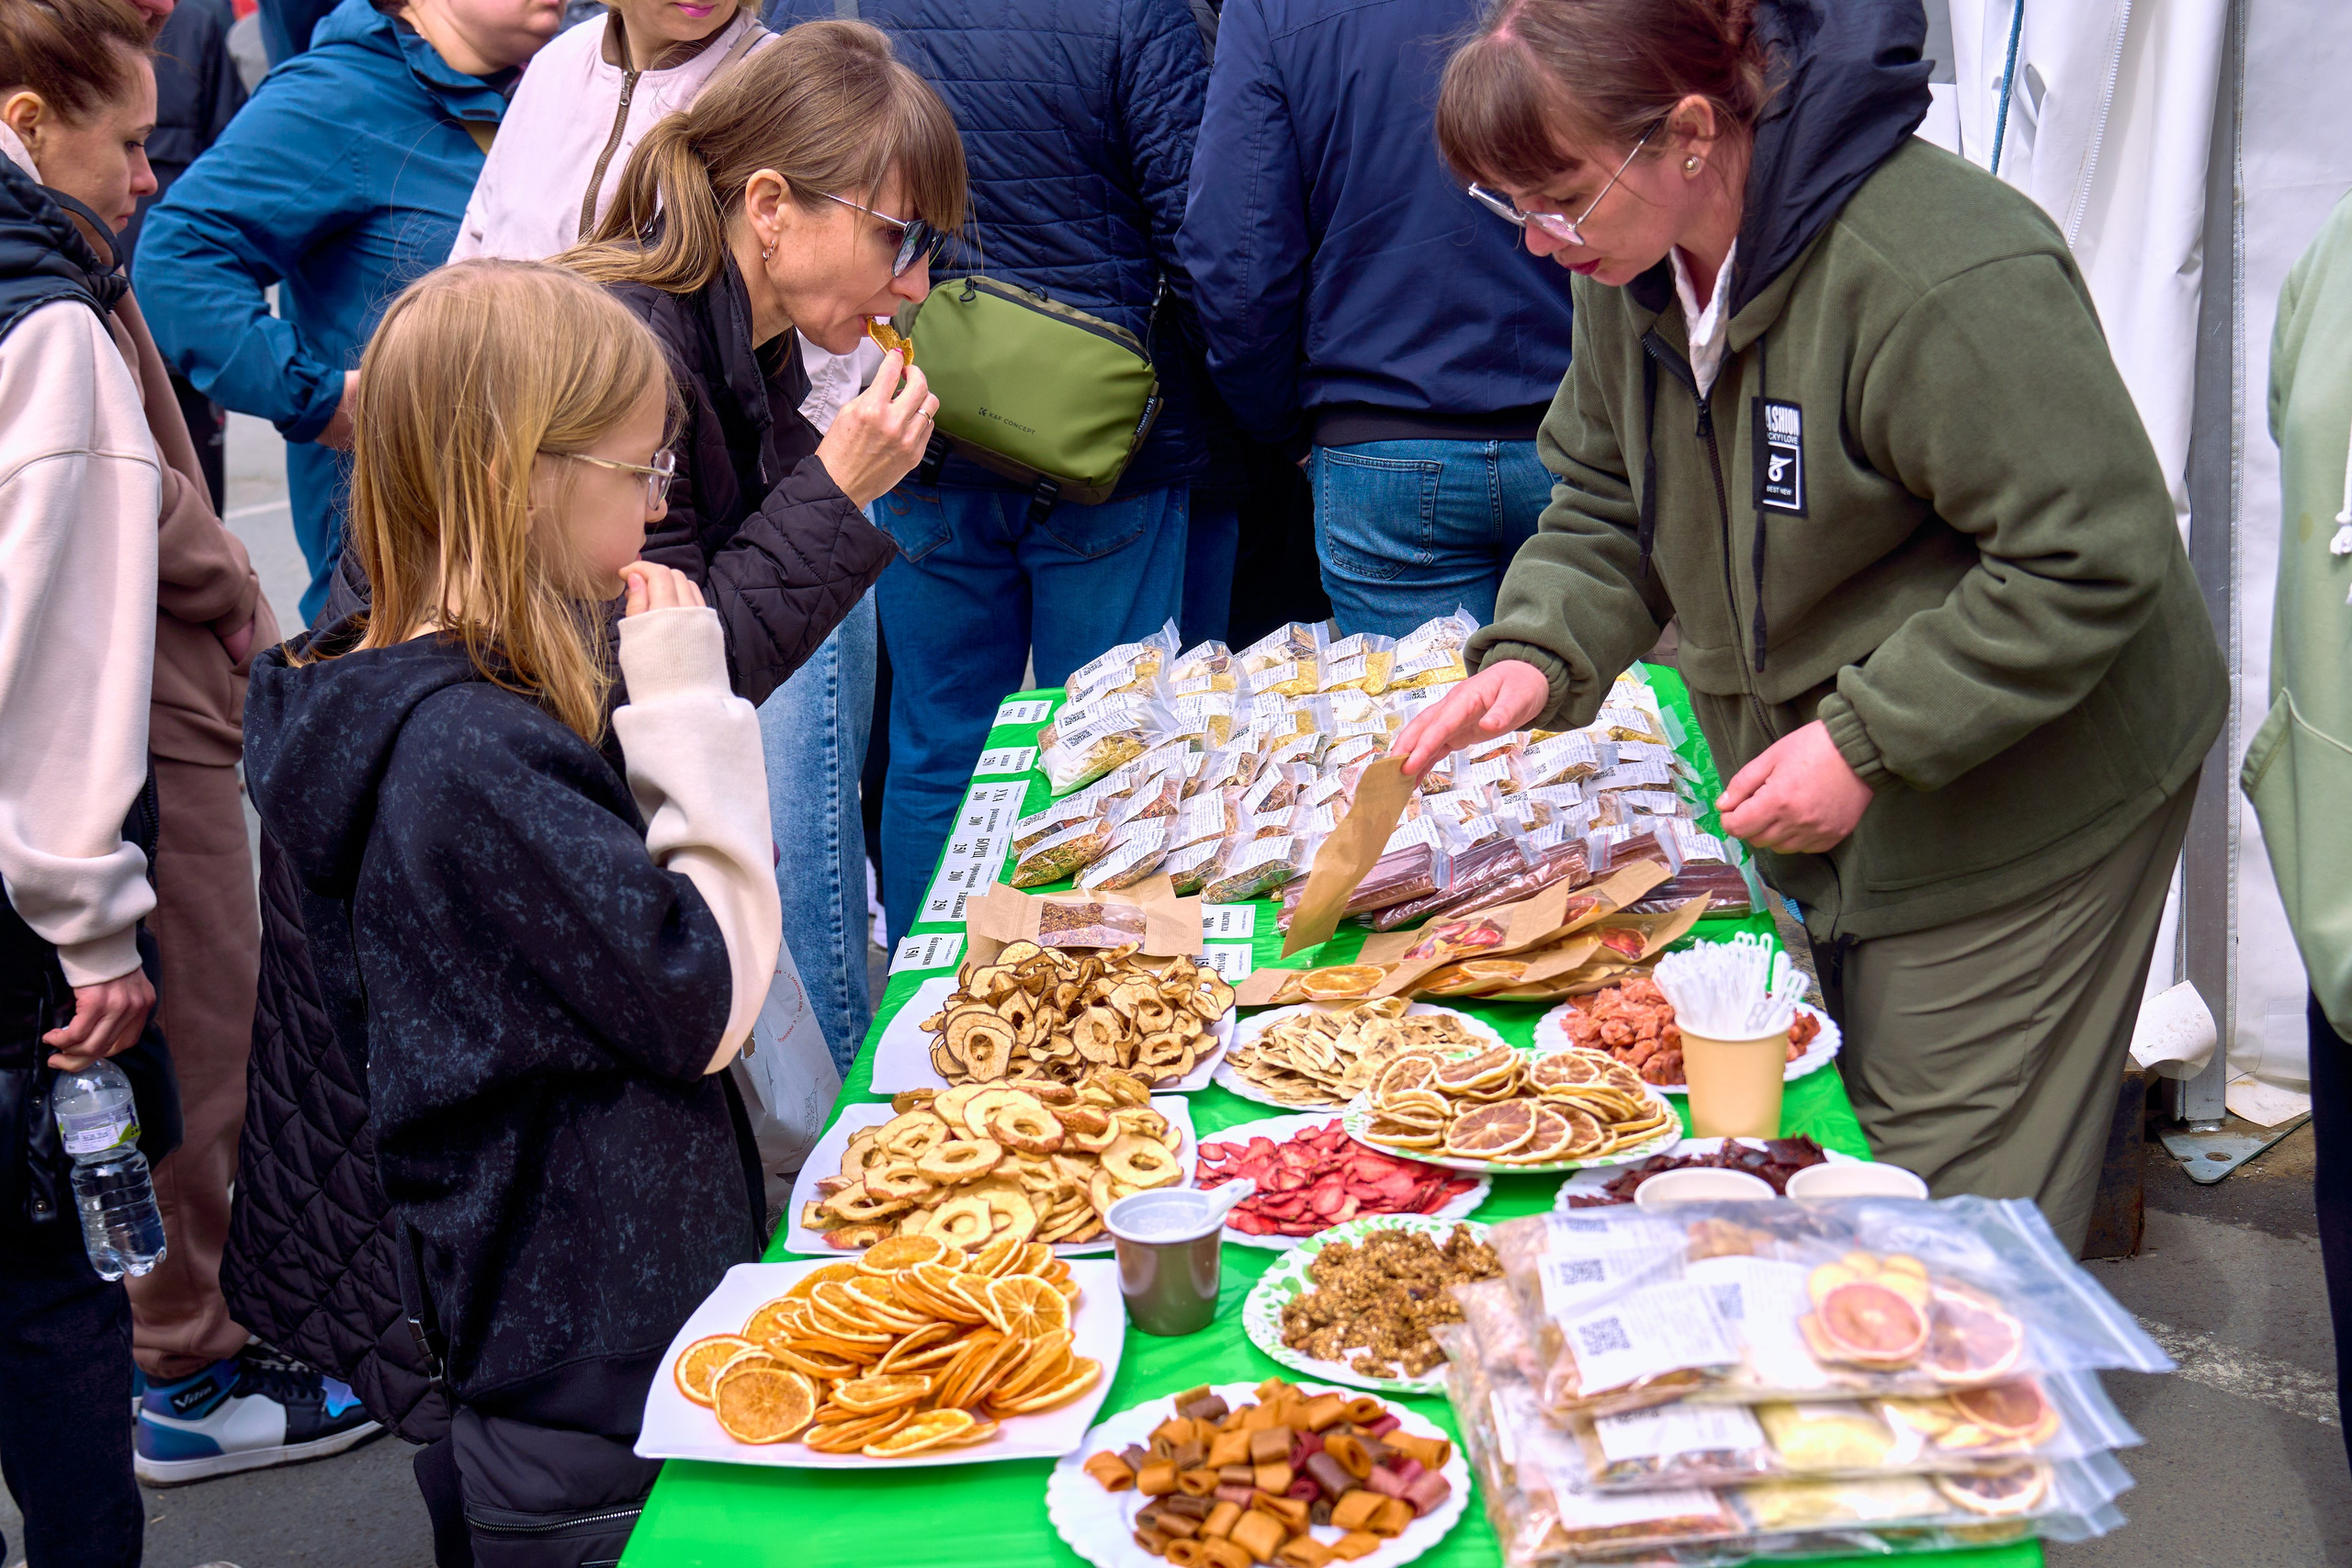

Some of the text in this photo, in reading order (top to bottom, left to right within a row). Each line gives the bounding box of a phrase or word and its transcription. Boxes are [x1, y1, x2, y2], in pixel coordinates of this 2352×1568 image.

[989, 412, 1036, 435] K&F CONCEPT
[1765, 404, 1801, 436] ASHION
[1784, 434, 1798, 445] LOVE
[1766, 484, 1792, 496] BEST NEW
[982, 756, 996, 767] 150
[972, 791, 988, 801] 200
[992, 788, 1009, 803] УХА
[968, 816, 984, 826] 200
[953, 843, 967, 854] 250
[970, 838, 990, 859] БОРЩ
[947, 870, 965, 882] 200
[931, 899, 948, 911] 250
[1203, 917, 1215, 929] 300
[1220, 911, 1231, 931] пастила
[903, 946, 921, 959] 150
[922, 936, 943, 965] батончики
[1194, 957, 1210, 967] 15
